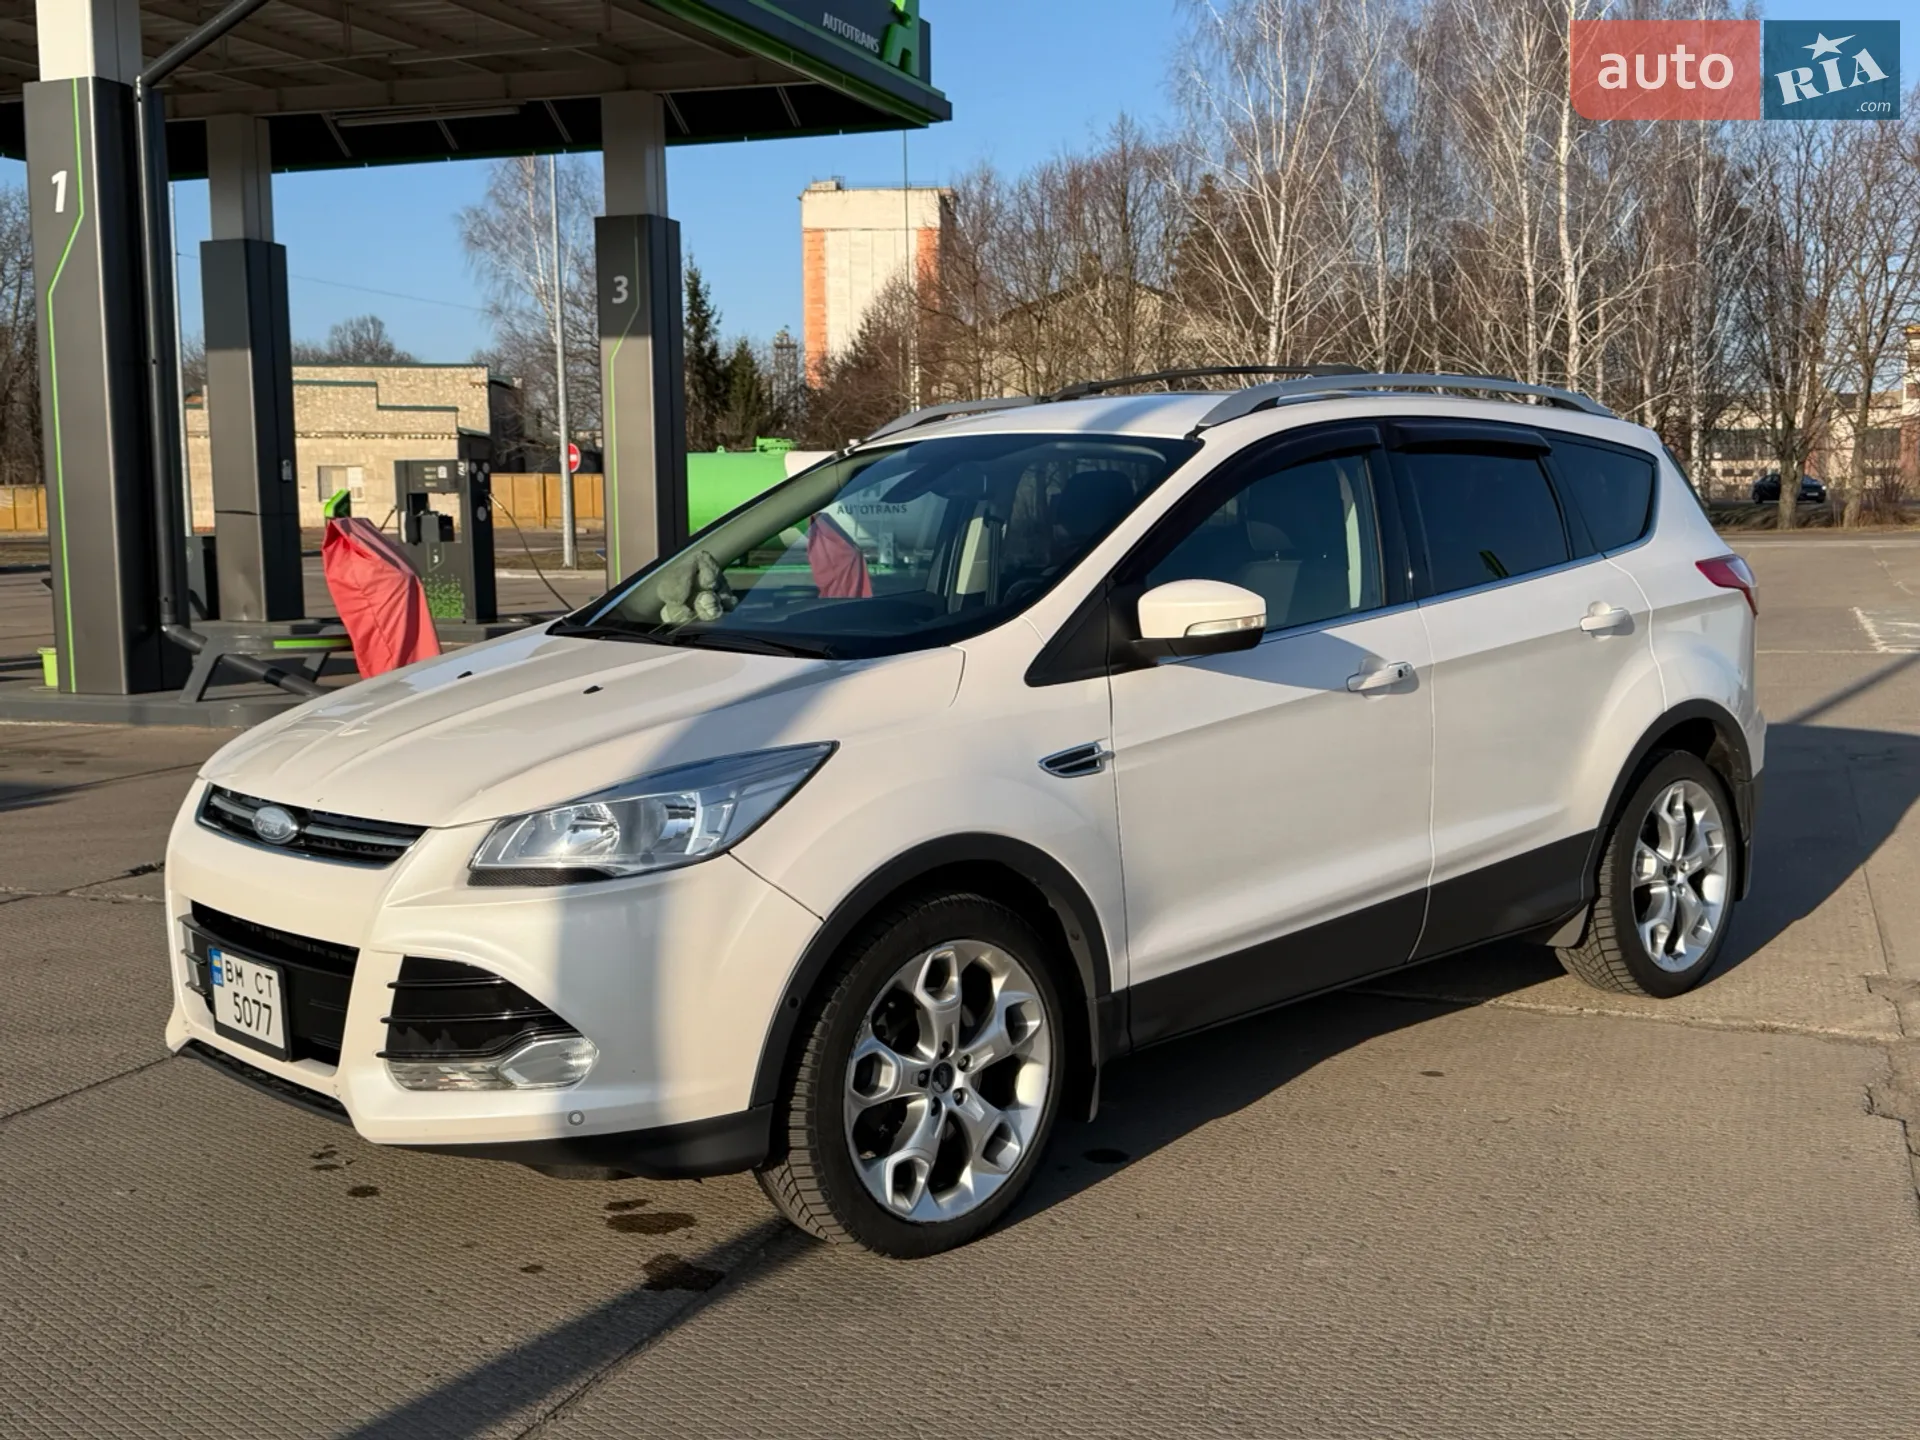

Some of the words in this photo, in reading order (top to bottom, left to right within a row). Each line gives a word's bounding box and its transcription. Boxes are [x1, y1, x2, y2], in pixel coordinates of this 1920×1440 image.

[822, 12, 880, 53] AUTOTRANS
[51, 170, 67, 213] 1
[611, 275, 629, 304] 3
[225, 960, 245, 988] BM
[254, 972, 274, 998] CT
[232, 991, 272, 1036] 5077
